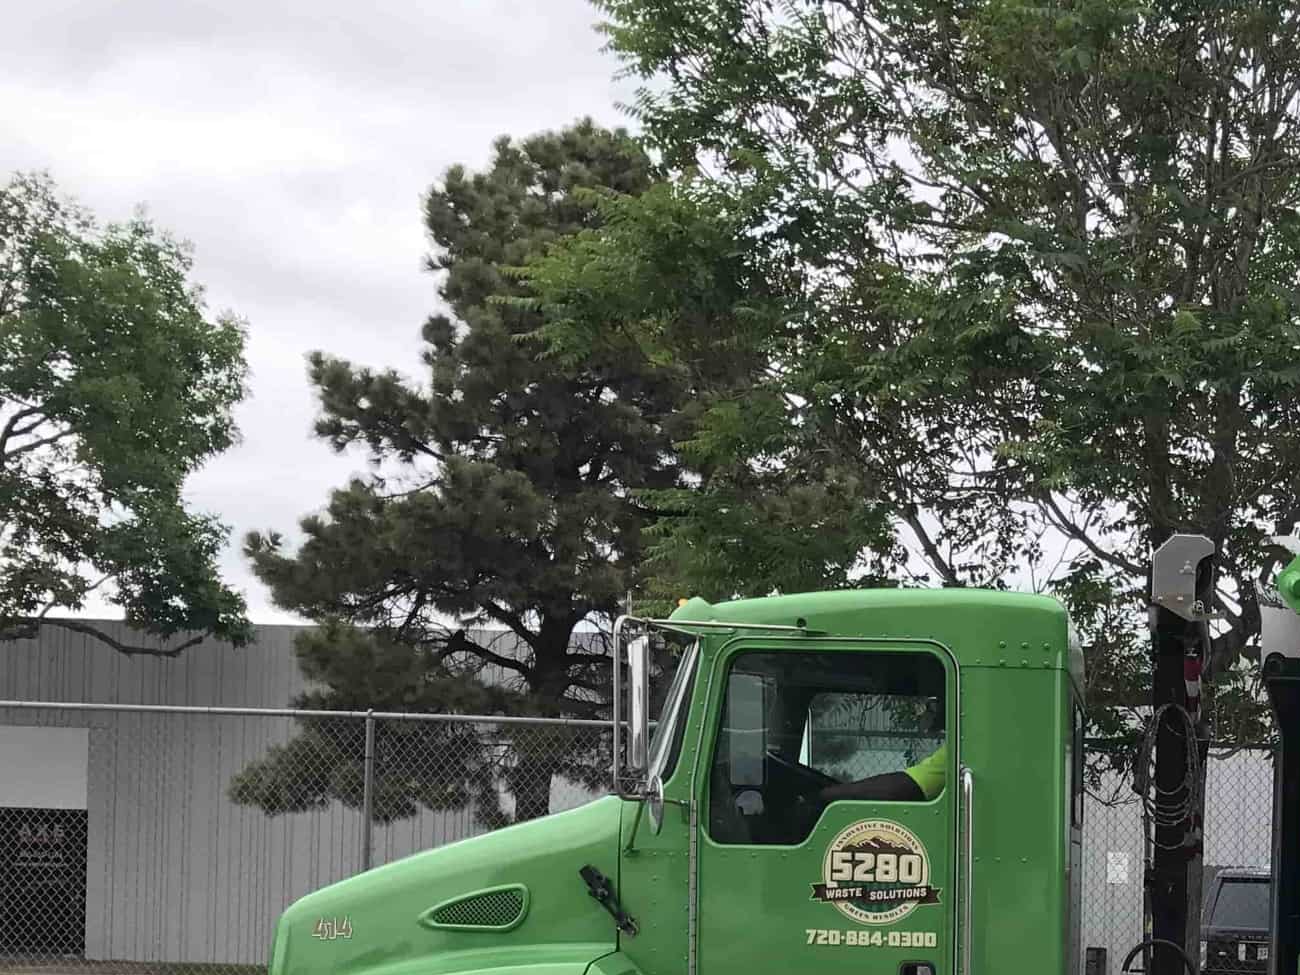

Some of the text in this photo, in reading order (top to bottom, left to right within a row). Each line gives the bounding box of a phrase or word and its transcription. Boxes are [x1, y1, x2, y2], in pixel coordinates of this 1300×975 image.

[831, 850, 923, 883] 5280
[826, 888, 927, 900] WASTE SOLUTIONS
